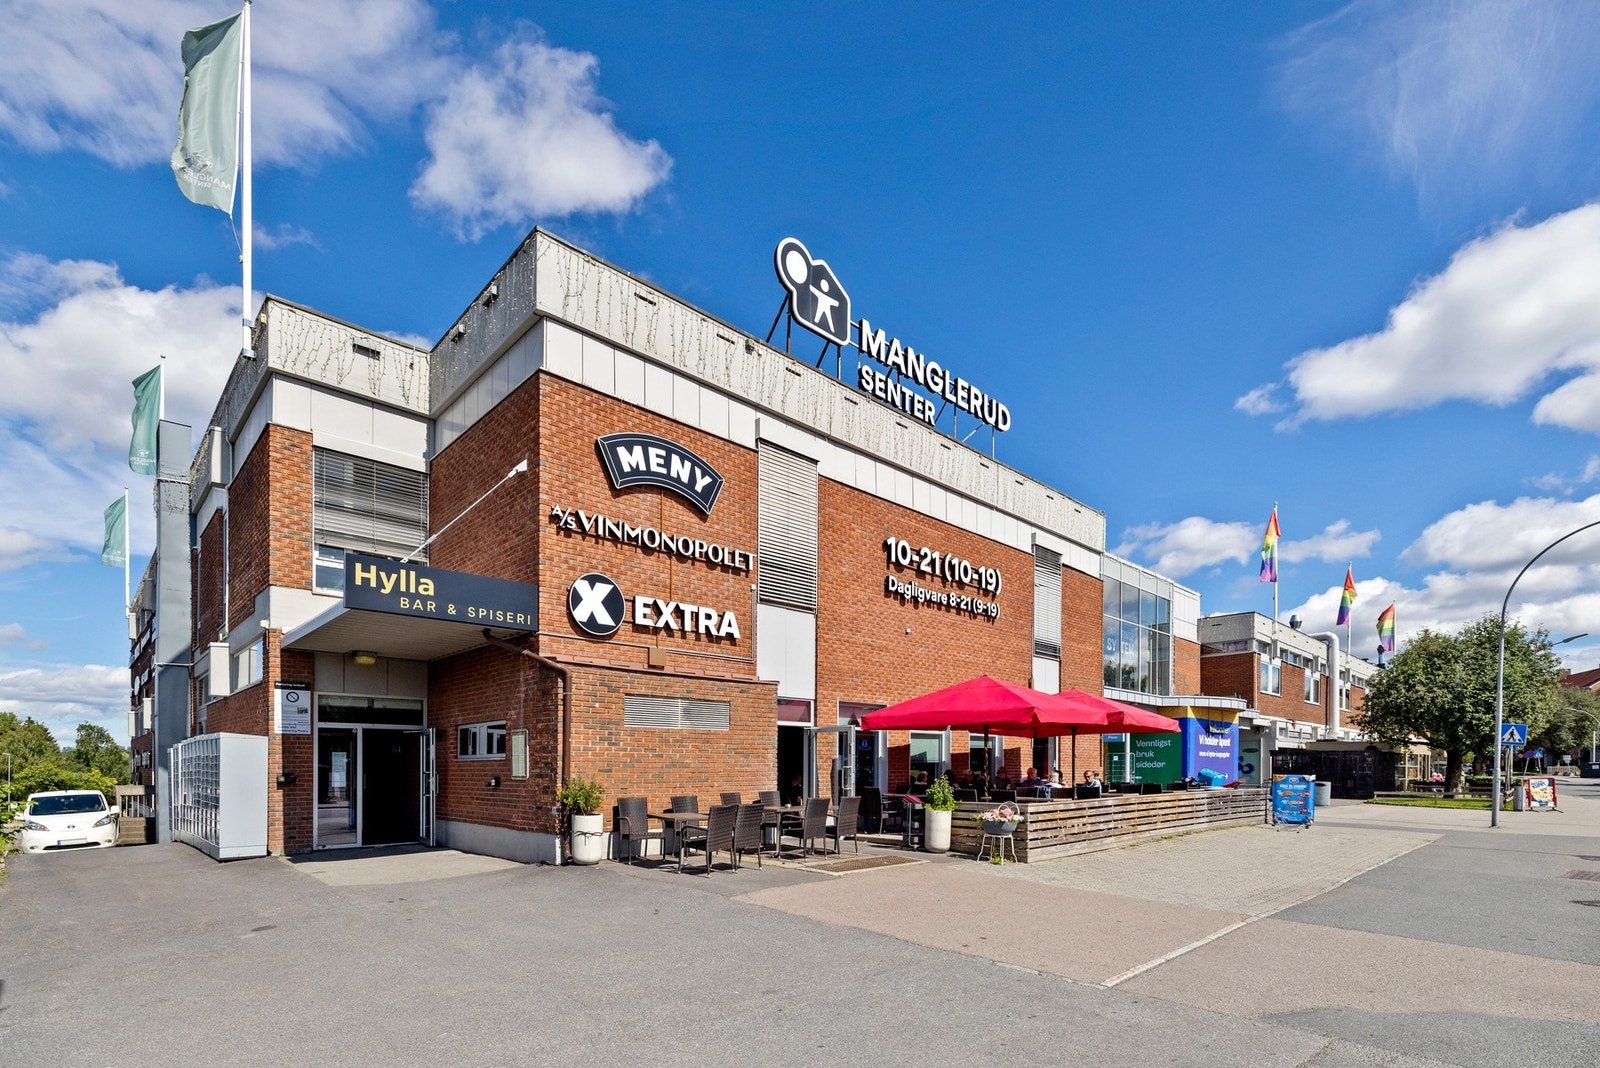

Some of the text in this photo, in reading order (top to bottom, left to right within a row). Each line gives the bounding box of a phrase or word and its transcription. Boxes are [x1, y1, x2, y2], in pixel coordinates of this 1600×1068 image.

[859, 318, 1011, 432] MANGLERUD
[859, 364, 936, 426] SENTER
[616, 445, 713, 493] MENY
[551, 504, 756, 571] A/S VINMONOPOLET
[354, 562, 435, 597] Hylla
[886, 536, 1002, 596] 10-21 (10-19)
[400, 597, 531, 625] BAR & SPISERI
[634, 595, 741, 639] EXTRA
[888, 575, 1001, 619] Dagligvare 8-21 (9-19)
[1135, 739, 1171, 748] Vennligst
[1135, 750, 1155, 758] bruk
[1135, 760, 1166, 769] sidedør
